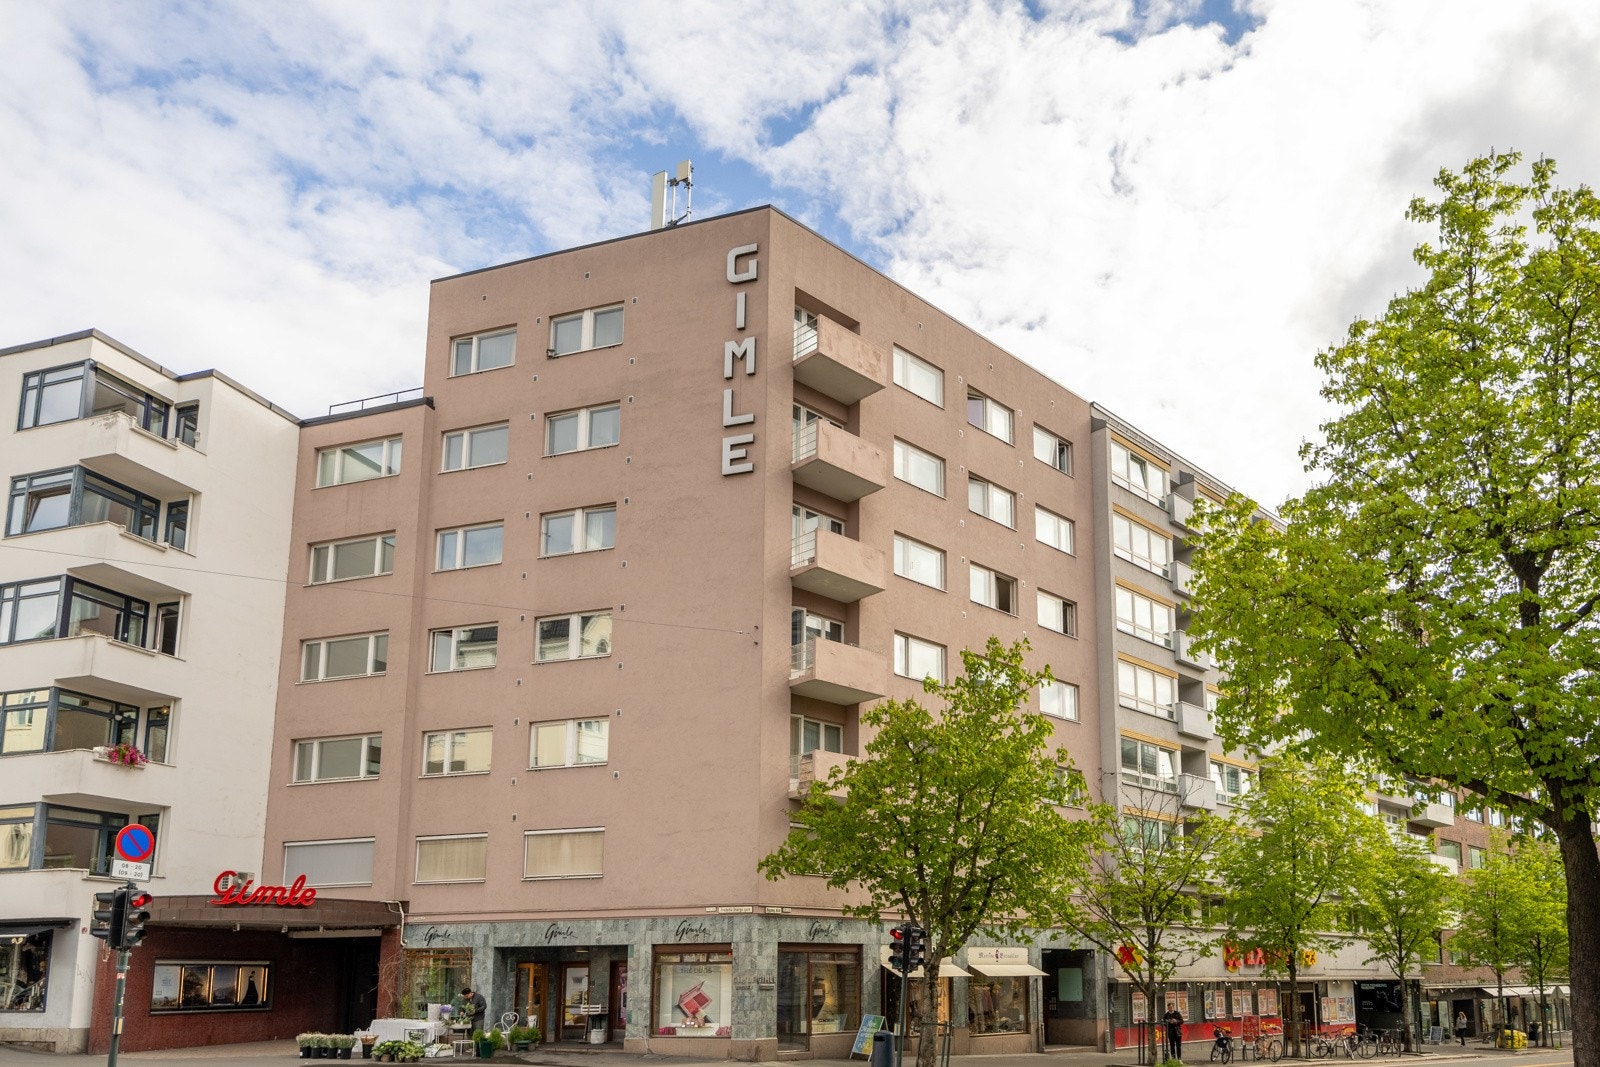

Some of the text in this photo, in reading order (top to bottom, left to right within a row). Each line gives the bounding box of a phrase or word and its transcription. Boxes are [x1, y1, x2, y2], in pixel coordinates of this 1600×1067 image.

[722, 243, 758, 476] GIMLE
[210, 870, 316, 907] Gimle
[424, 926, 456, 946] Gimle
[545, 923, 578, 944] Gimle
[676, 920, 711, 941] Gimle
[809, 920, 838, 941] Gimle
